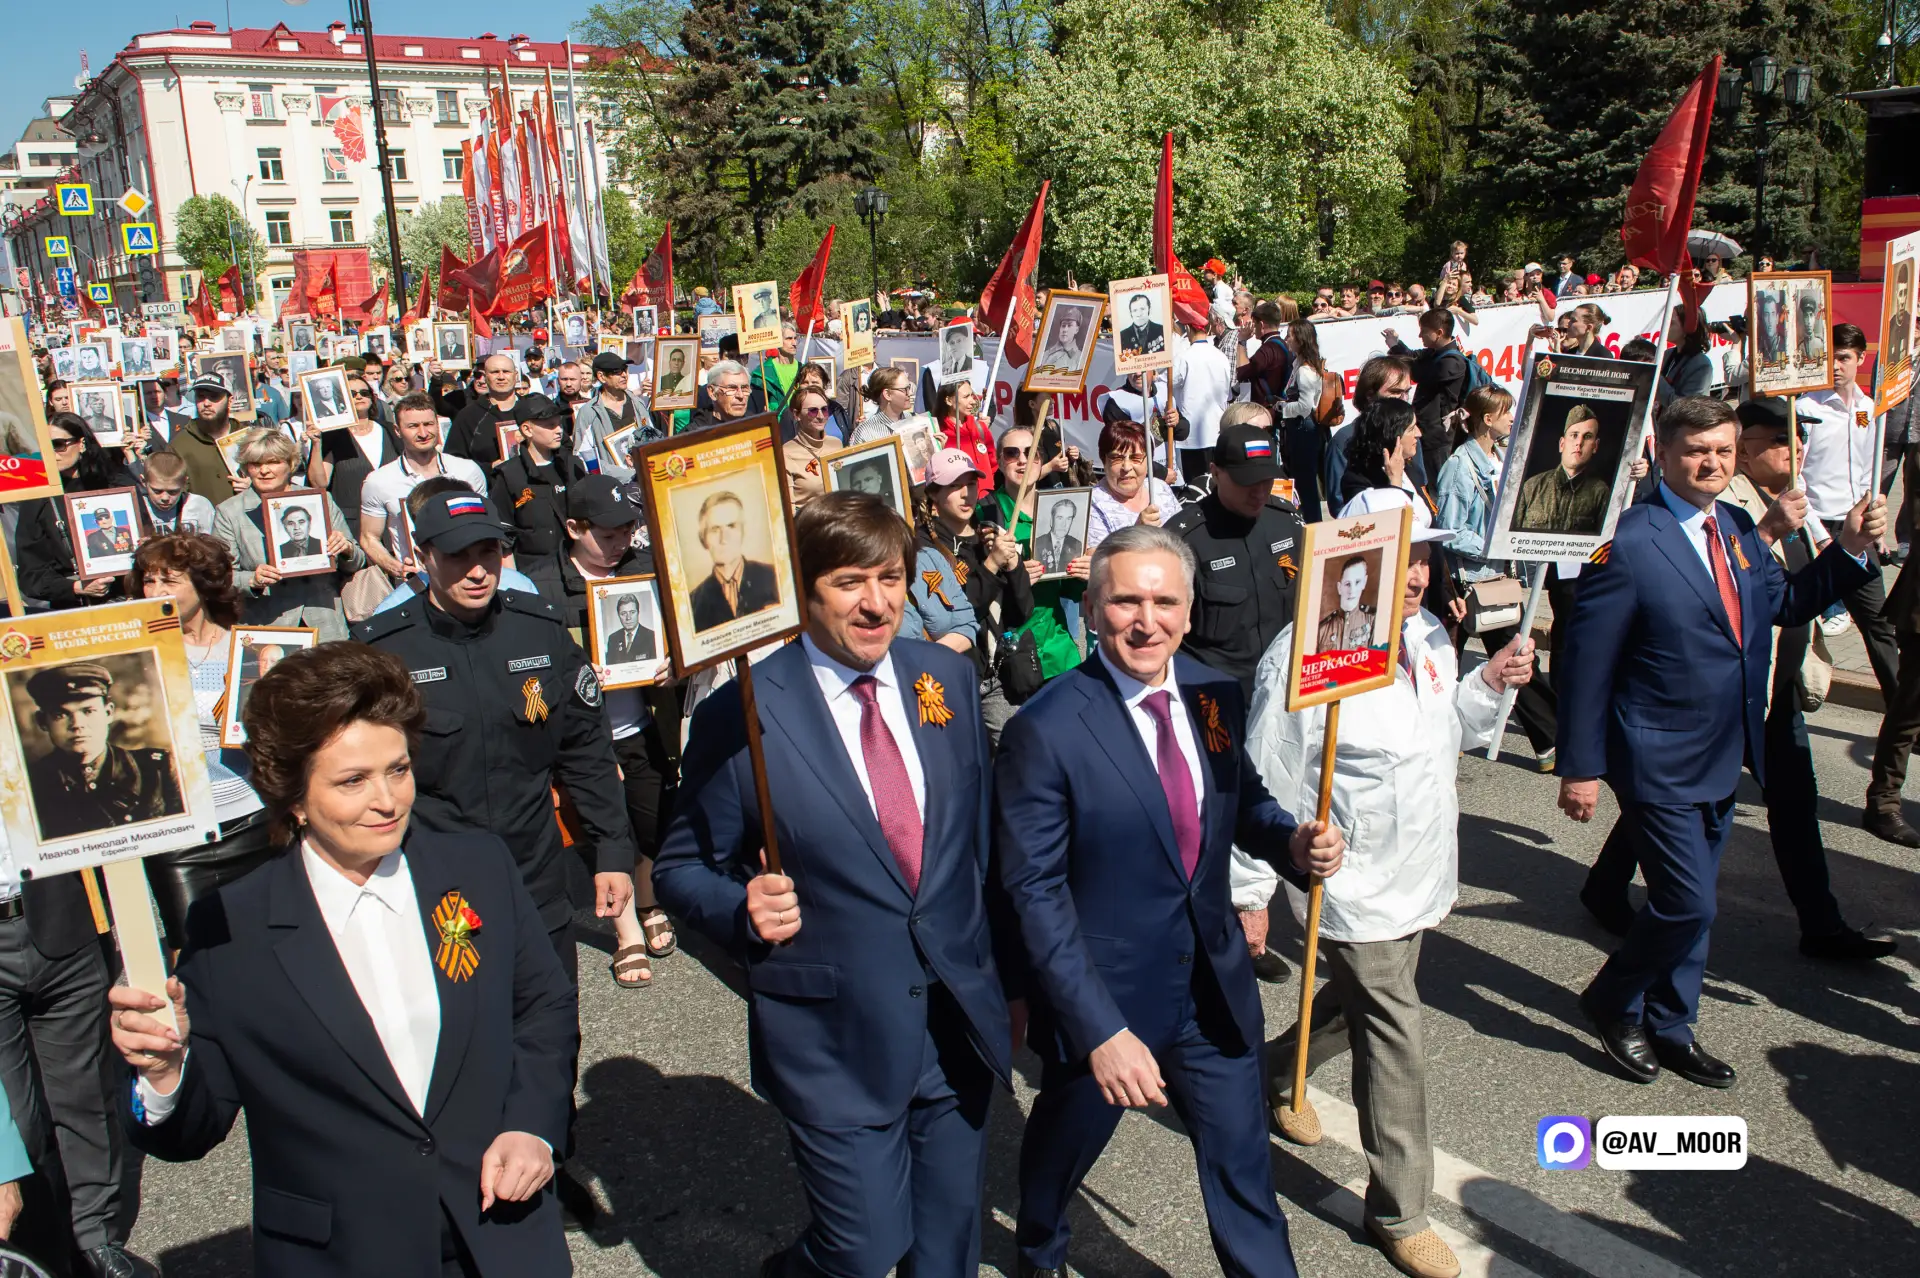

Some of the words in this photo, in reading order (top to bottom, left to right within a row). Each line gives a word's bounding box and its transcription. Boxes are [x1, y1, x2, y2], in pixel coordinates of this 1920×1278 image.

[148, 304, 176, 314] СТОП
[1559, 366, 1610, 378] БЕССМЕРТНЫЙ
[1610, 371, 1631, 380] ПОЛК
[1576, 386, 1597, 394] Кирилл
[696, 440, 752, 461] БЕССМЕРТНЫЙ
[700, 456, 722, 469] ПОЛК
[722, 450, 752, 463] РОССИИ
[1313, 542, 1357, 556] БЕССМЕРТНЫЙ
[1374, 534, 1396, 544] РОССИИ
[1512, 546, 1566, 556] «Бессмертный
[1532, 539, 1565, 548] портрета
[48, 619, 143, 641] БЕССМЕРТНЫЙ
[54, 636, 89, 650] ПОЛК
[91, 630, 142, 646] РОССИИ
[510, 656, 548, 670] ПОЛИЦИЯ
[1302, 650, 1369, 676] ЧЕРКАСОВ
[38, 846, 80, 862] Иванов
[82, 836, 128, 853] Николай
[130, 822, 196, 843] Михайлович
[101, 844, 139, 857] Ефрейтор
